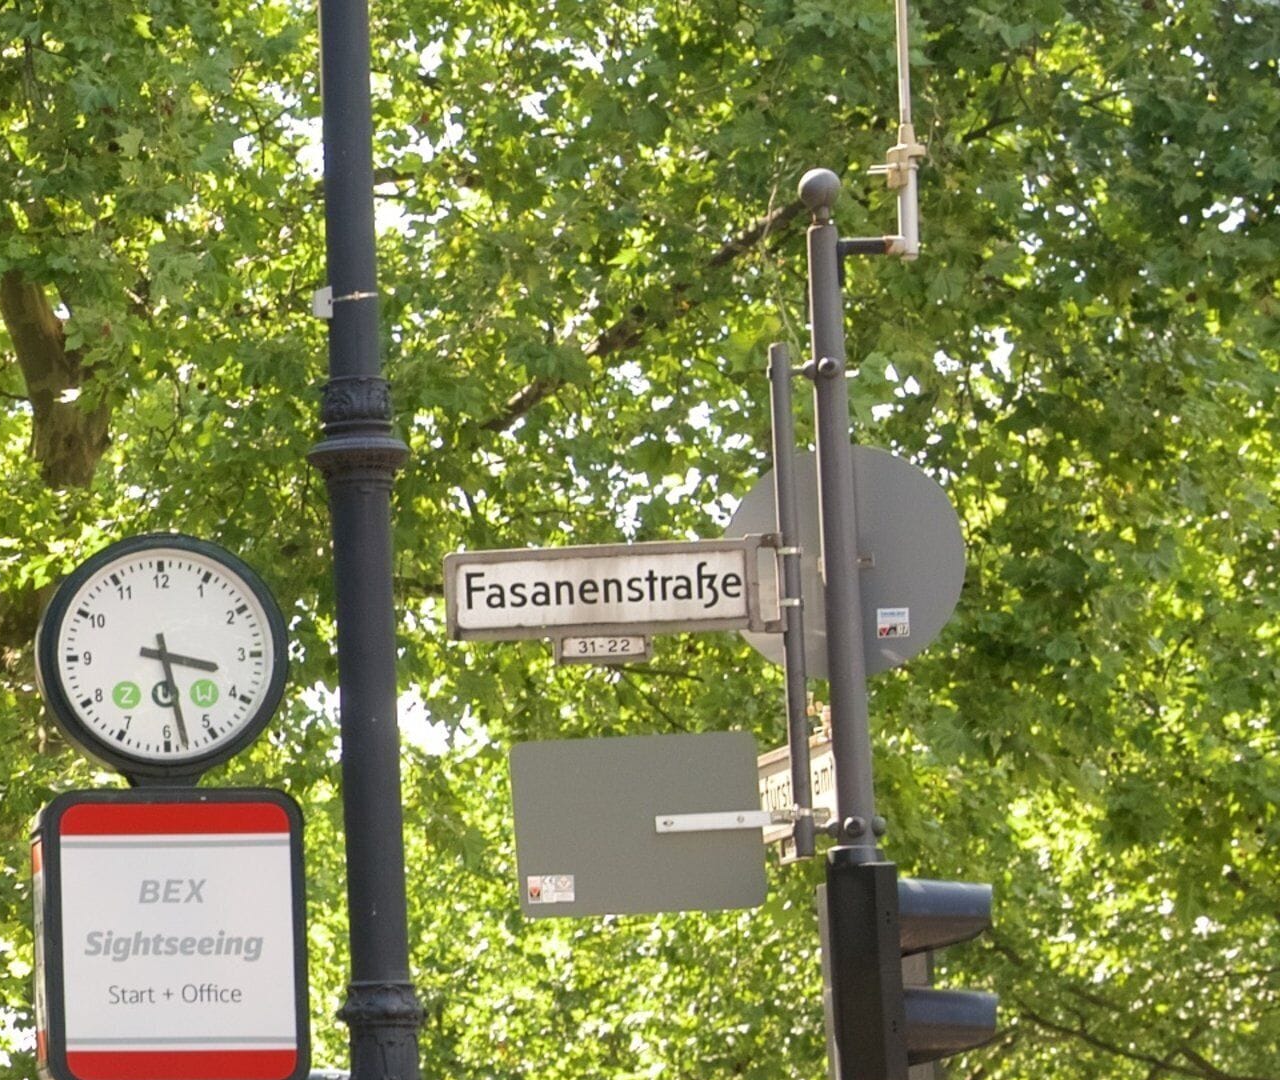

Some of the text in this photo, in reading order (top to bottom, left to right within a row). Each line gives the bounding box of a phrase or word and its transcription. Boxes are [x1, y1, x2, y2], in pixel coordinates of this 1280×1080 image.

[153, 574, 169, 589] 12
[464, 561, 742, 611] Fasanenstraße
[118, 586, 132, 600] 11
[198, 585, 204, 598] 1
[90, 614, 105, 628] 10
[226, 610, 235, 625] 2
[578, 637, 631, 655] 31-22
[83, 652, 92, 665] 9
[238, 648, 245, 662] 3
[95, 688, 103, 702] 8
[228, 685, 237, 699] 4
[124, 716, 132, 730] 7
[202, 714, 210, 729] 5
[163, 725, 171, 739] 6
[139, 879, 205, 903] BEX
[85, 932, 262, 961] Sightseeing
[109, 985, 154, 1003] Start
[181, 984, 241, 1003] Office
